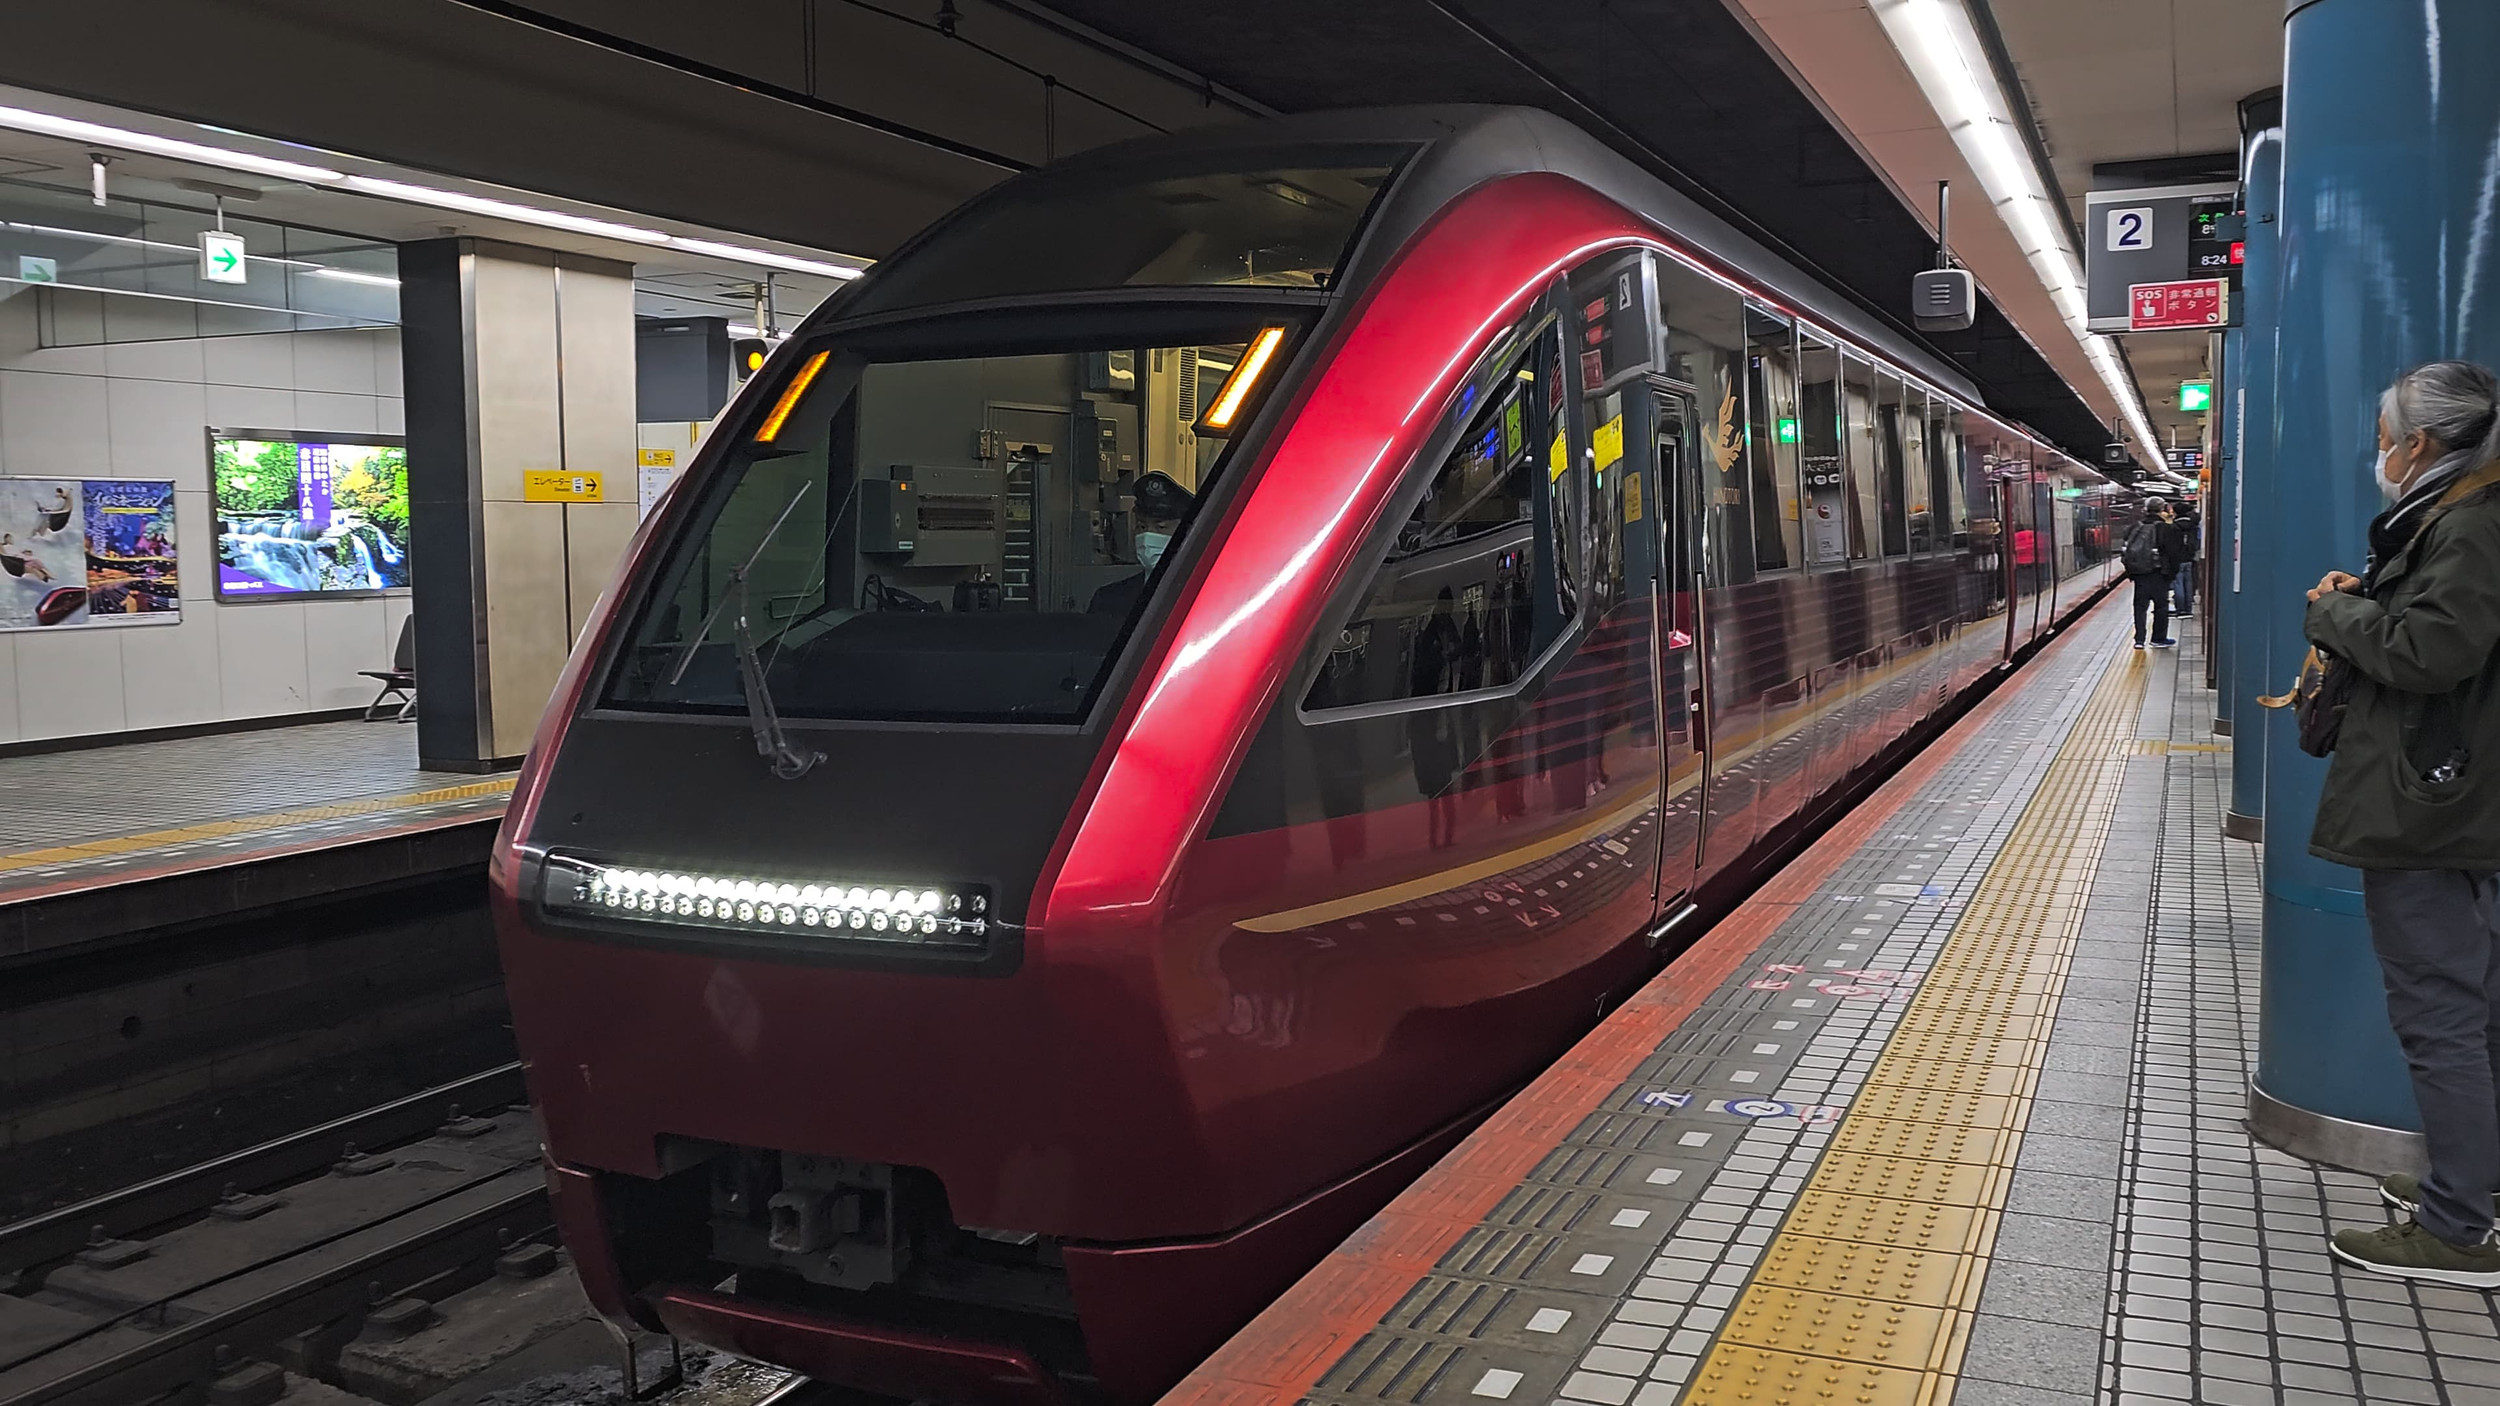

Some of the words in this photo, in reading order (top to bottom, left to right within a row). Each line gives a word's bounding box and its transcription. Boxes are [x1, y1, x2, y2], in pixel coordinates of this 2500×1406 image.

[2118, 213, 2142, 246] 2
[2136, 290, 2162, 300] SOS
[2168, 287, 2217, 299] 非常通報
[2168, 300, 2216, 310] ボタン
[533, 477, 571, 485] エレベーター
[91, 491, 165, 507] イルミネーション
[1744, 1104, 1775, 1112] 2
